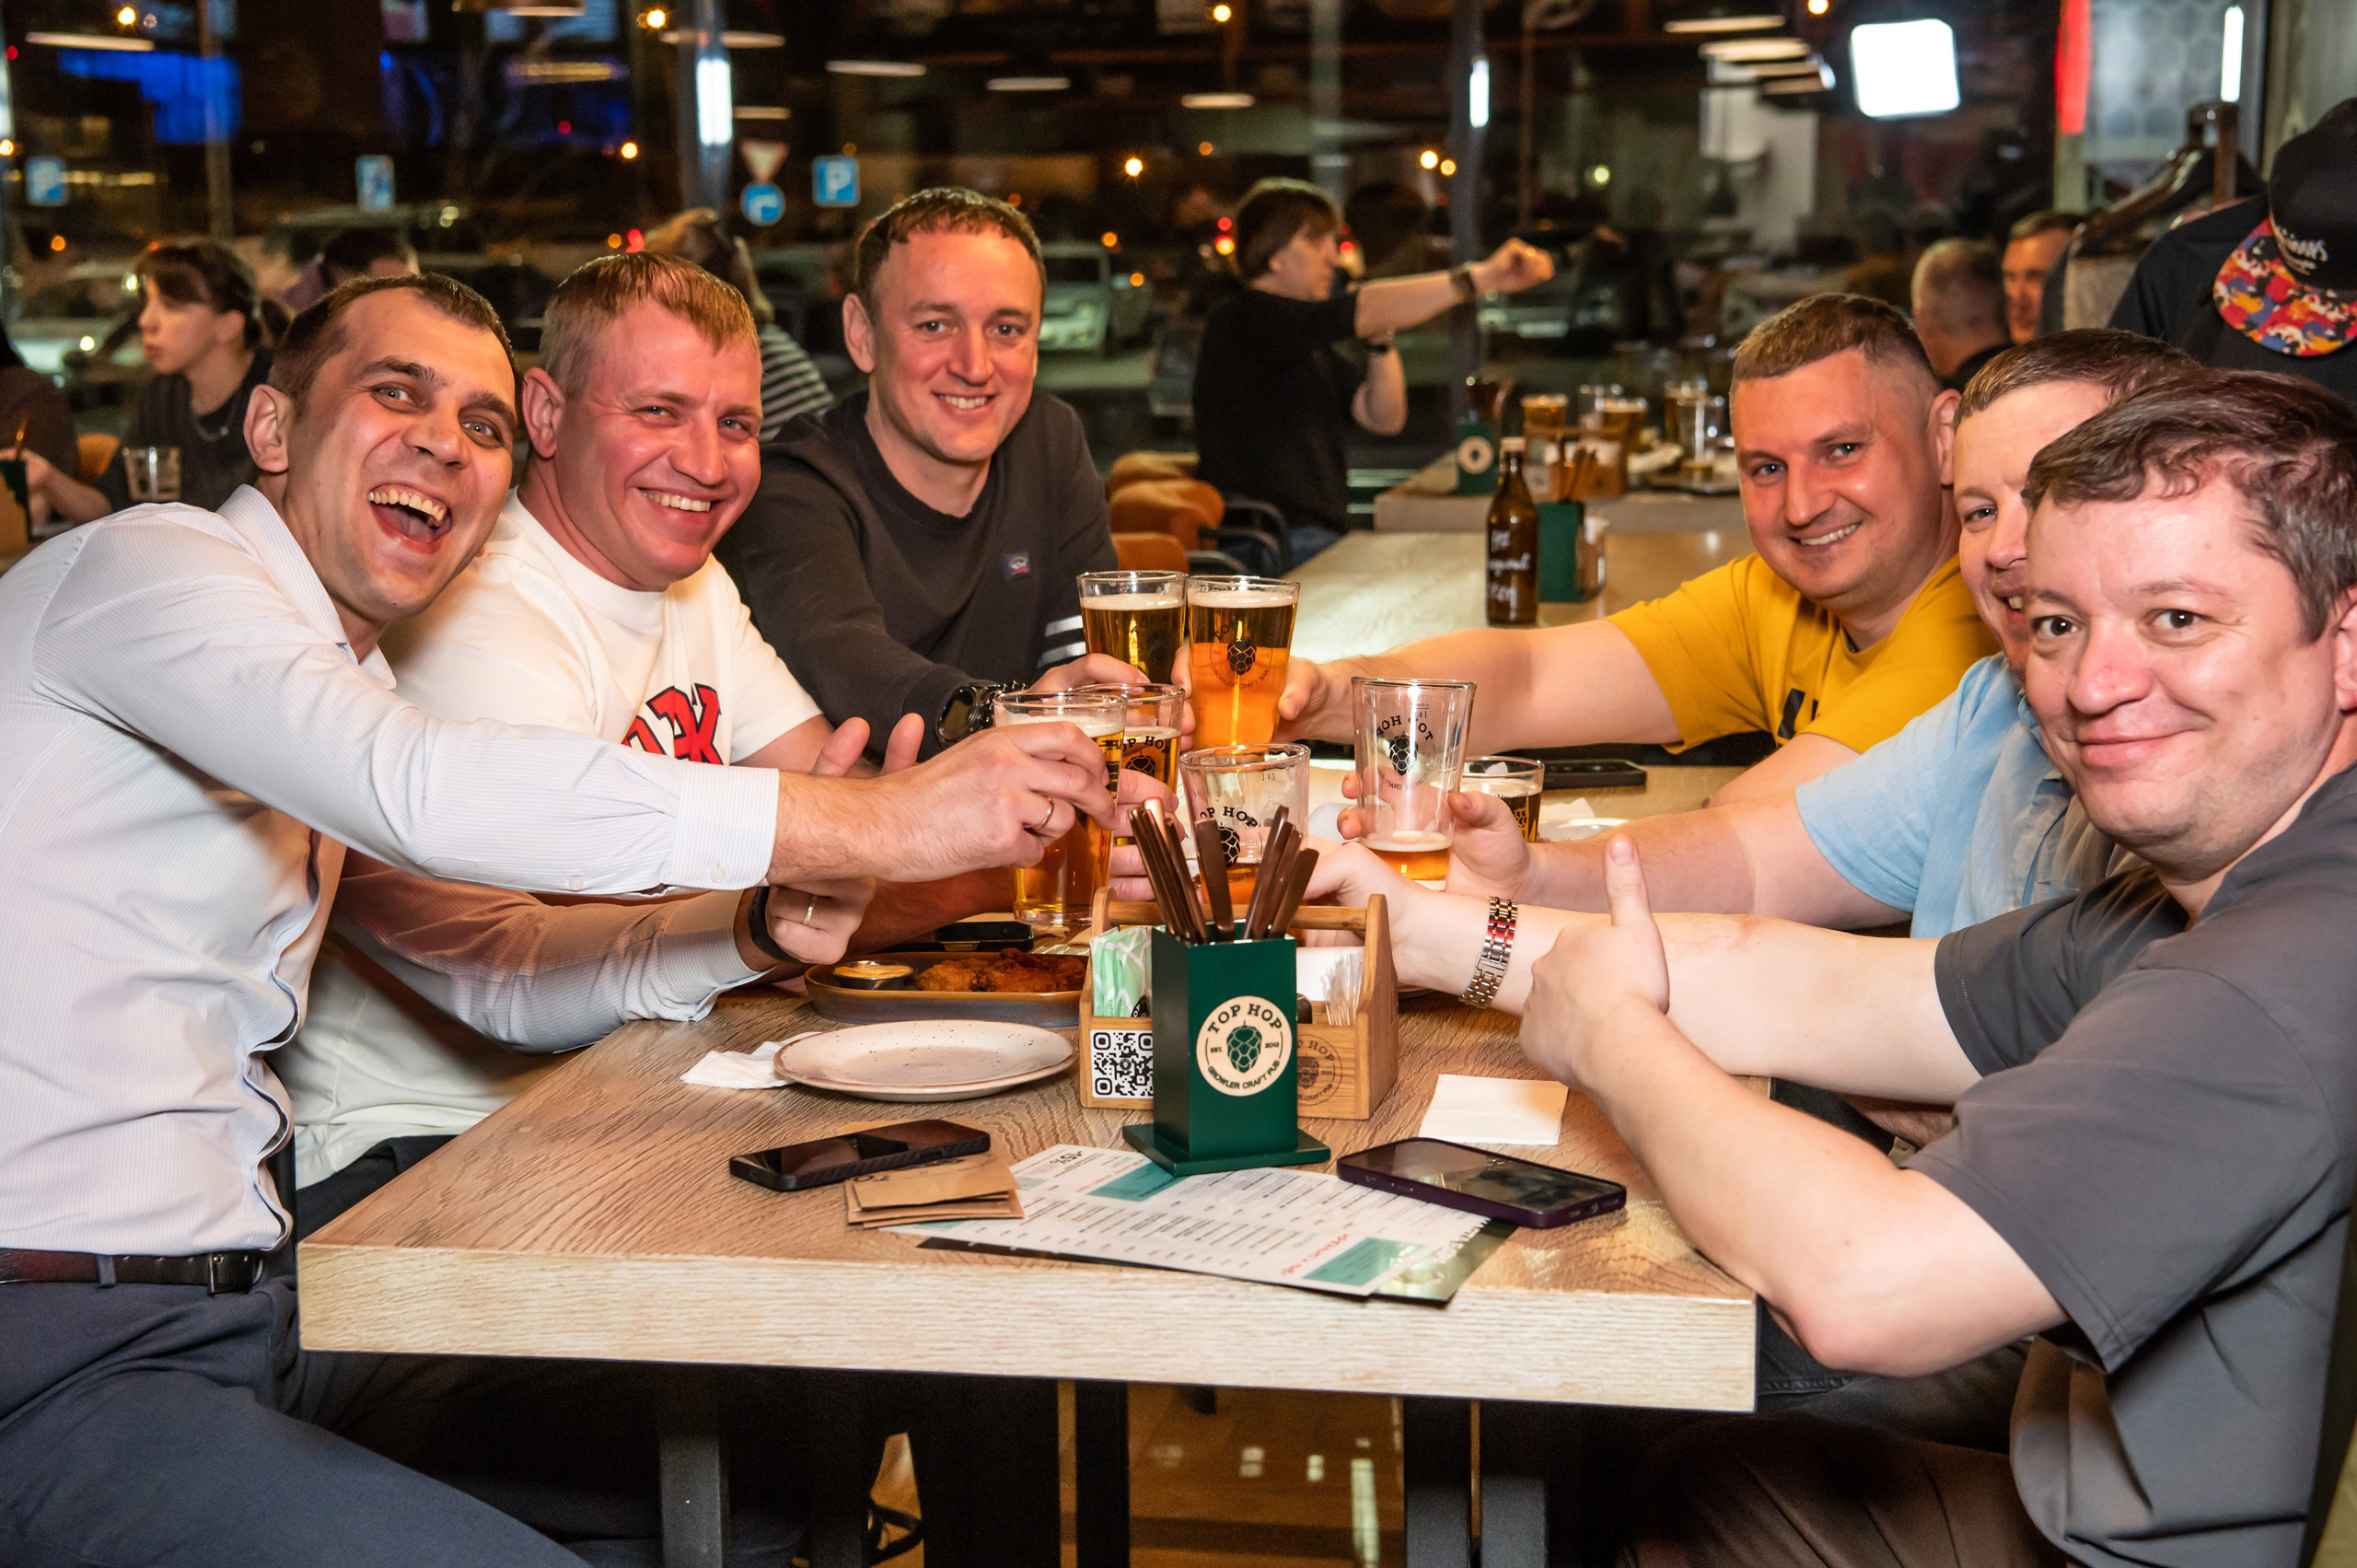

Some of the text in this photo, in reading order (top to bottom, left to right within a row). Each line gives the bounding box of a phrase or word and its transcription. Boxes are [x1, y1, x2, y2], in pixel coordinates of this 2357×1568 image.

[826, 161, 852, 200] P
[1239, 679, 1258, 690] CRAFT
[1259, 668, 1270, 681] BAR
[1223, 806, 1259, 828] HOP
[1207, 1003, 1282, 1034] TOP HOP
[1307, 1040, 1335, 1062] HOP
[1208, 1060, 1281, 1090] GROWLER CRAFT PUB
[1304, 1091, 1323, 1101] CRAFT
[1049, 1150, 1083, 1166] -15%
